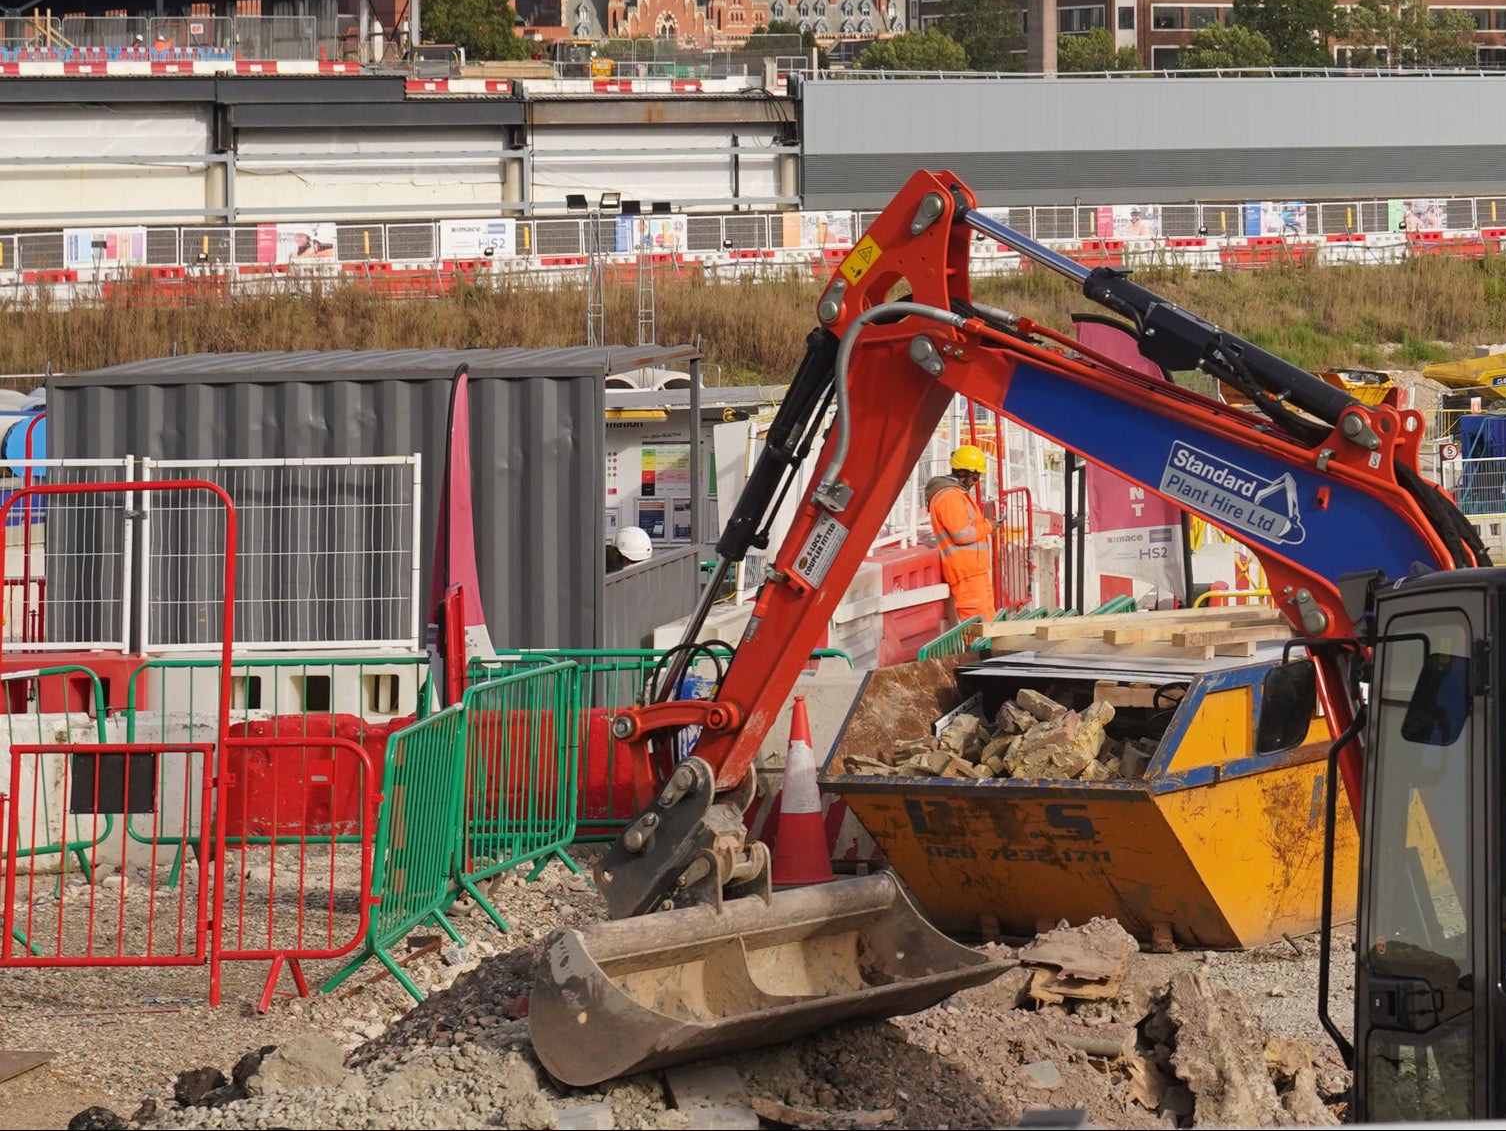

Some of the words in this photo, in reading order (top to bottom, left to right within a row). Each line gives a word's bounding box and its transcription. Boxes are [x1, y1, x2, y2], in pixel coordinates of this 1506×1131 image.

[478, 237, 506, 249] HS2
[1446, 446, 1454, 456] 5
[1174, 449, 1258, 498] Standard
[1166, 474, 1209, 504] Plant
[1210, 493, 1244, 520] Hire
[1246, 510, 1276, 533] Ltd
[804, 545, 825, 576] COUPLER
[820, 523, 836, 547] FITTED
[1139, 546, 1168, 561] HS2
